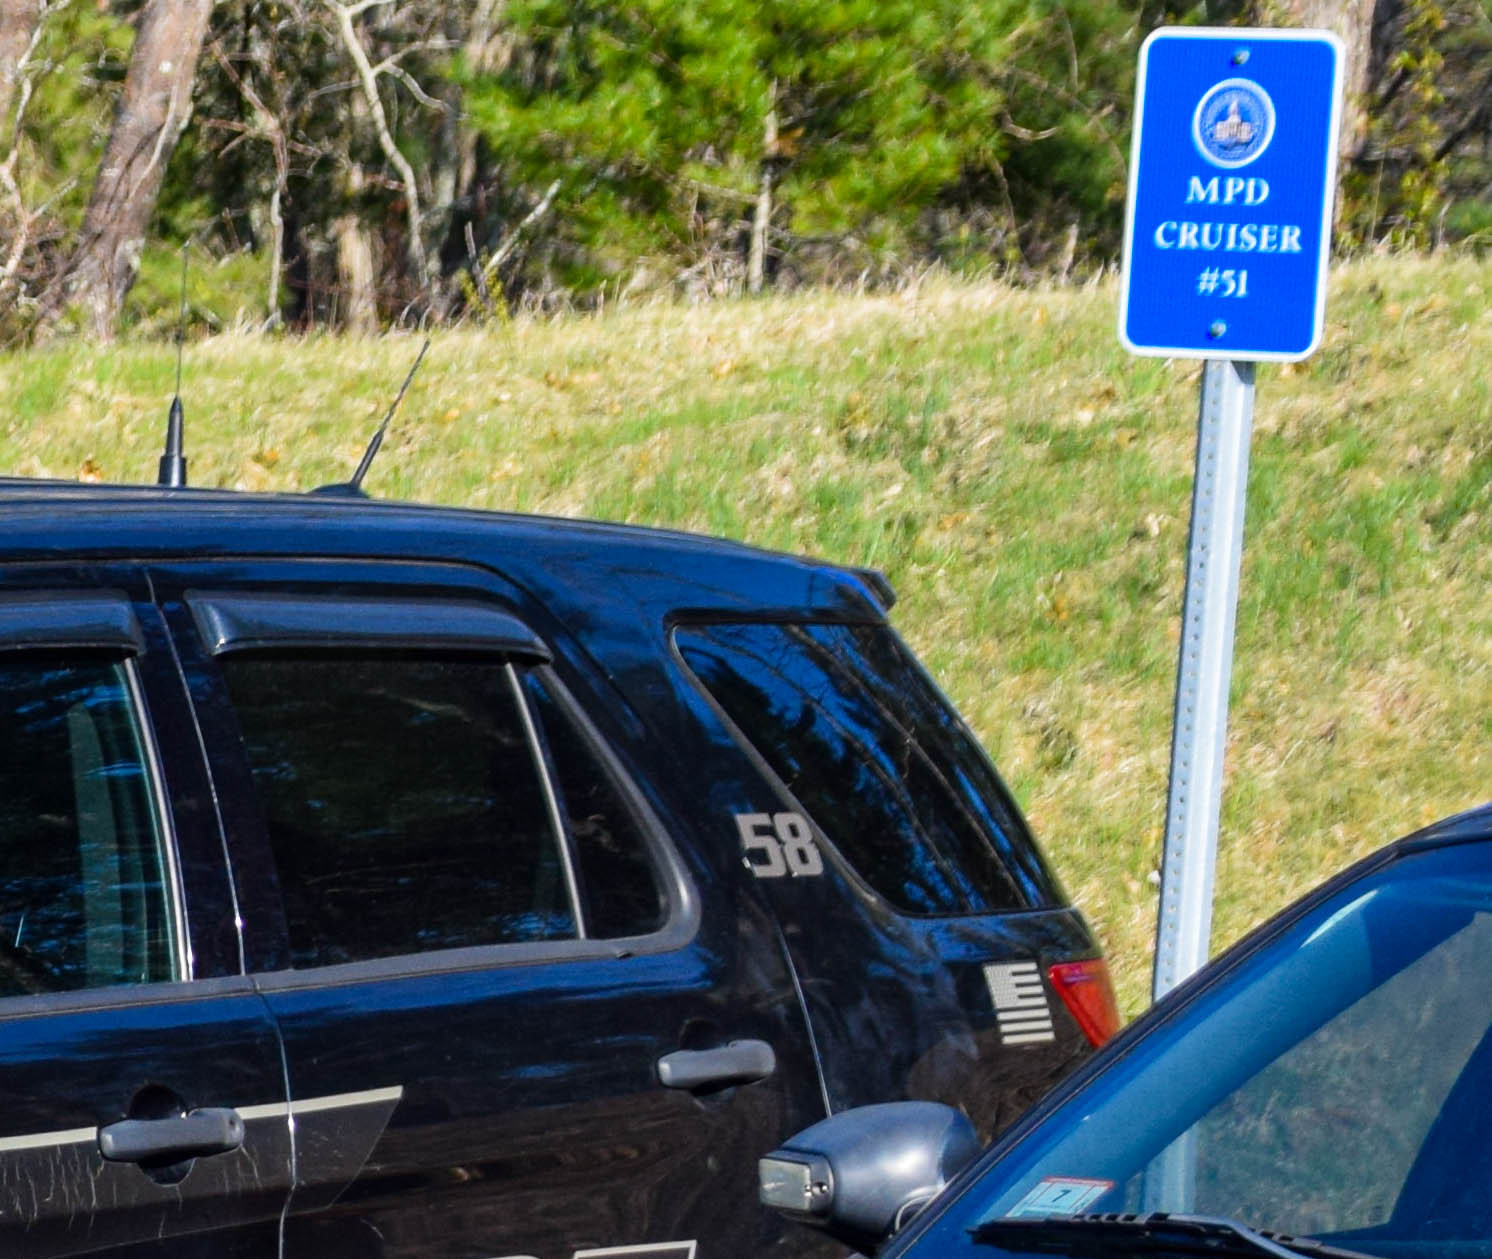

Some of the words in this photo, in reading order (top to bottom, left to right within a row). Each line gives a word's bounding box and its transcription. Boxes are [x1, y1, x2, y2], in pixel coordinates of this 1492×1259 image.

[1185, 176, 1269, 205] MPD
[1154, 221, 1302, 253] CRUISER
[1196, 266, 1248, 297] #51
[734, 812, 823, 878] 58
